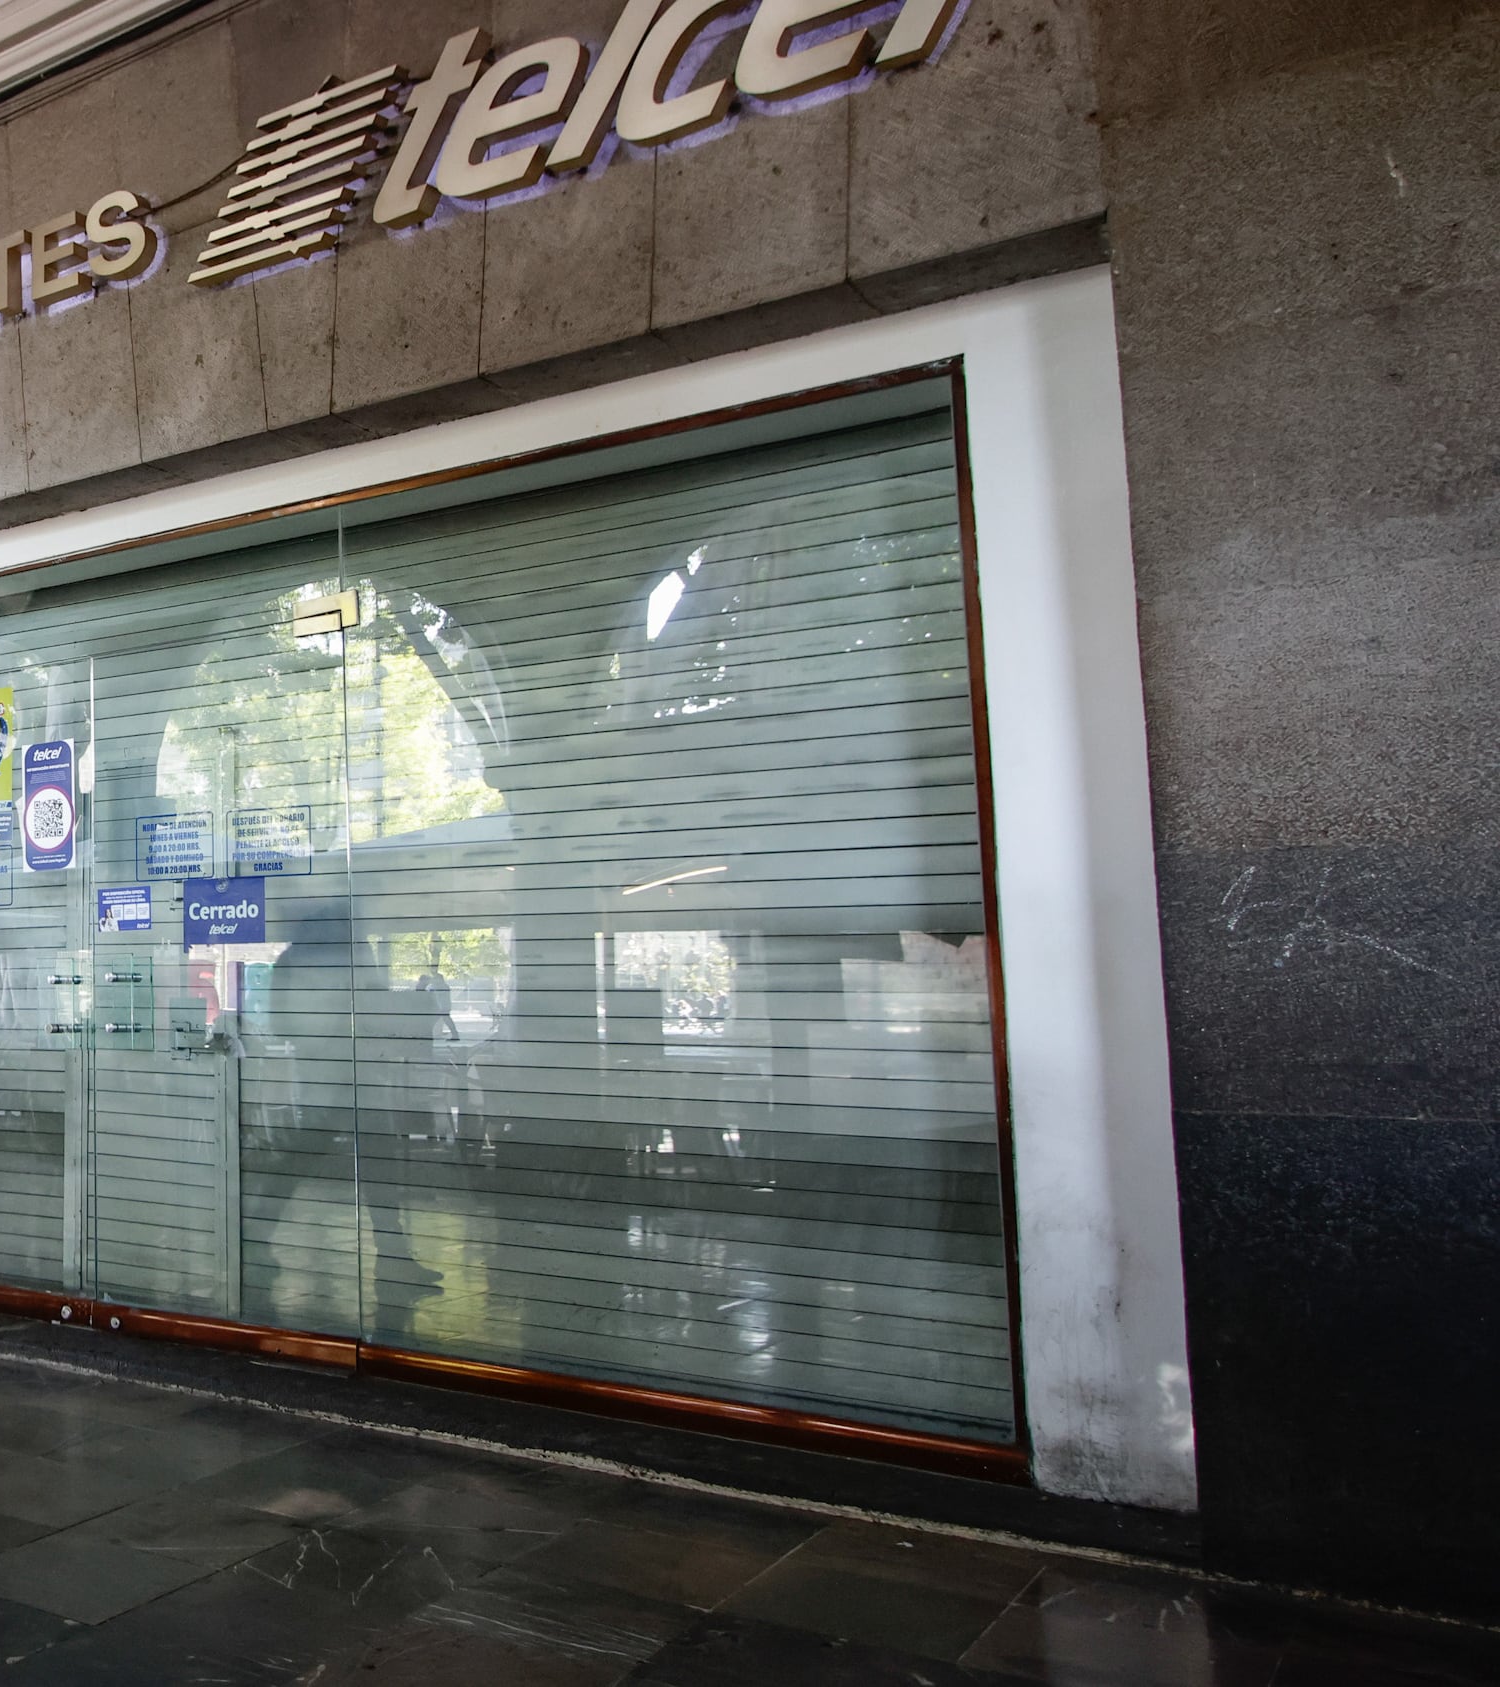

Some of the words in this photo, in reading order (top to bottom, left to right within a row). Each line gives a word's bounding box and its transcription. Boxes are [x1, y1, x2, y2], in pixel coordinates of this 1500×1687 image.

[373, 0, 950, 230] telce
[33, 746, 62, 762] telcel
[174, 831, 199, 841] VIERNES
[253, 861, 283, 872] GRACIAS
[188, 900, 259, 921] Cerrado
[208, 922, 238, 935] telcel
